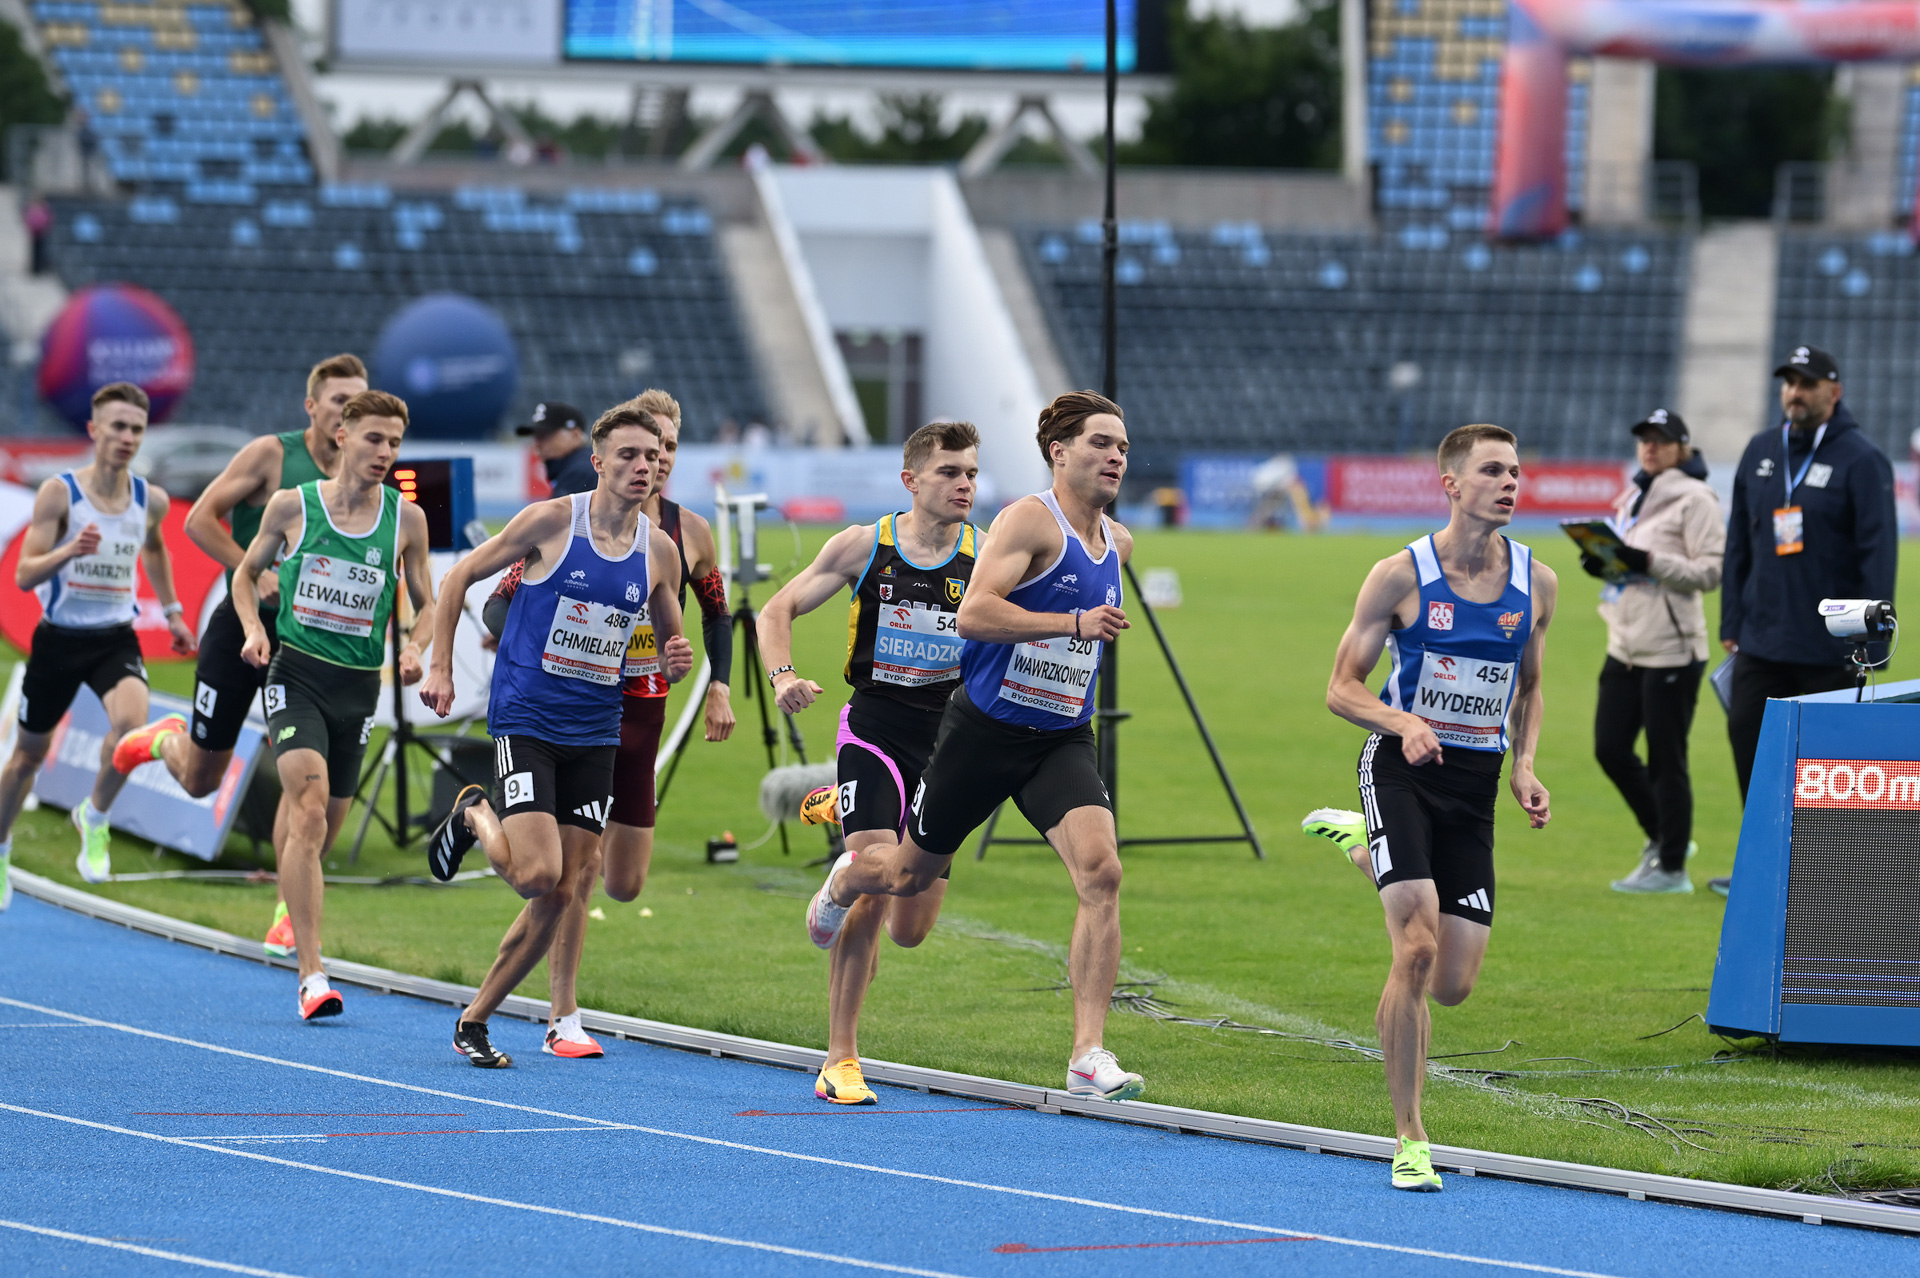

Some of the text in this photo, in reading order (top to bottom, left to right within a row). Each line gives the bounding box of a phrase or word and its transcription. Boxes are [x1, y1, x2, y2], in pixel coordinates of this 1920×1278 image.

[311, 568, 331, 577] ORLEN
[347, 566, 378, 585] 535
[299, 581, 375, 611] LEWALSKI
[566, 615, 588, 625] ORLEN
[604, 613, 630, 629] 488
[889, 621, 912, 630] ORLEN
[936, 616, 958, 633] 54
[1497, 610, 1524, 626] AWF
[552, 628, 624, 658] CHMIELARZ
[627, 633, 656, 650] OWS
[878, 636, 962, 662] SIERADZK
[1067, 637, 1092, 655] 520
[551, 664, 612, 683] BYDGOSZCZ 2025
[642, 665, 657, 673] 2025
[883, 672, 950, 684] BYDGOSZCZ 2025
[889, 665, 904, 673] PZLA
[1013, 654, 1091, 688] WAWRZKOWICZ
[1433, 672, 1457, 681] ORLEN
[1476, 665, 1509, 684] 454
[200, 690, 210, 711] 4
[1011, 692, 1075, 713] BYDGOSZCZ 2025
[1020, 685, 1034, 695] PZLA
[1034, 689, 1069, 703] Mistrzostwa
[1421, 686, 1502, 716] WYDERKA
[1428, 721, 1443, 729] PZLA
[1444, 723, 1482, 734] Mistrzostwa
[1433, 731, 1472, 743] DGOSZCZ
[1798, 765, 1920, 801] 800m
[841, 785, 851, 813] 6
[1370, 841, 1381, 874] 7
